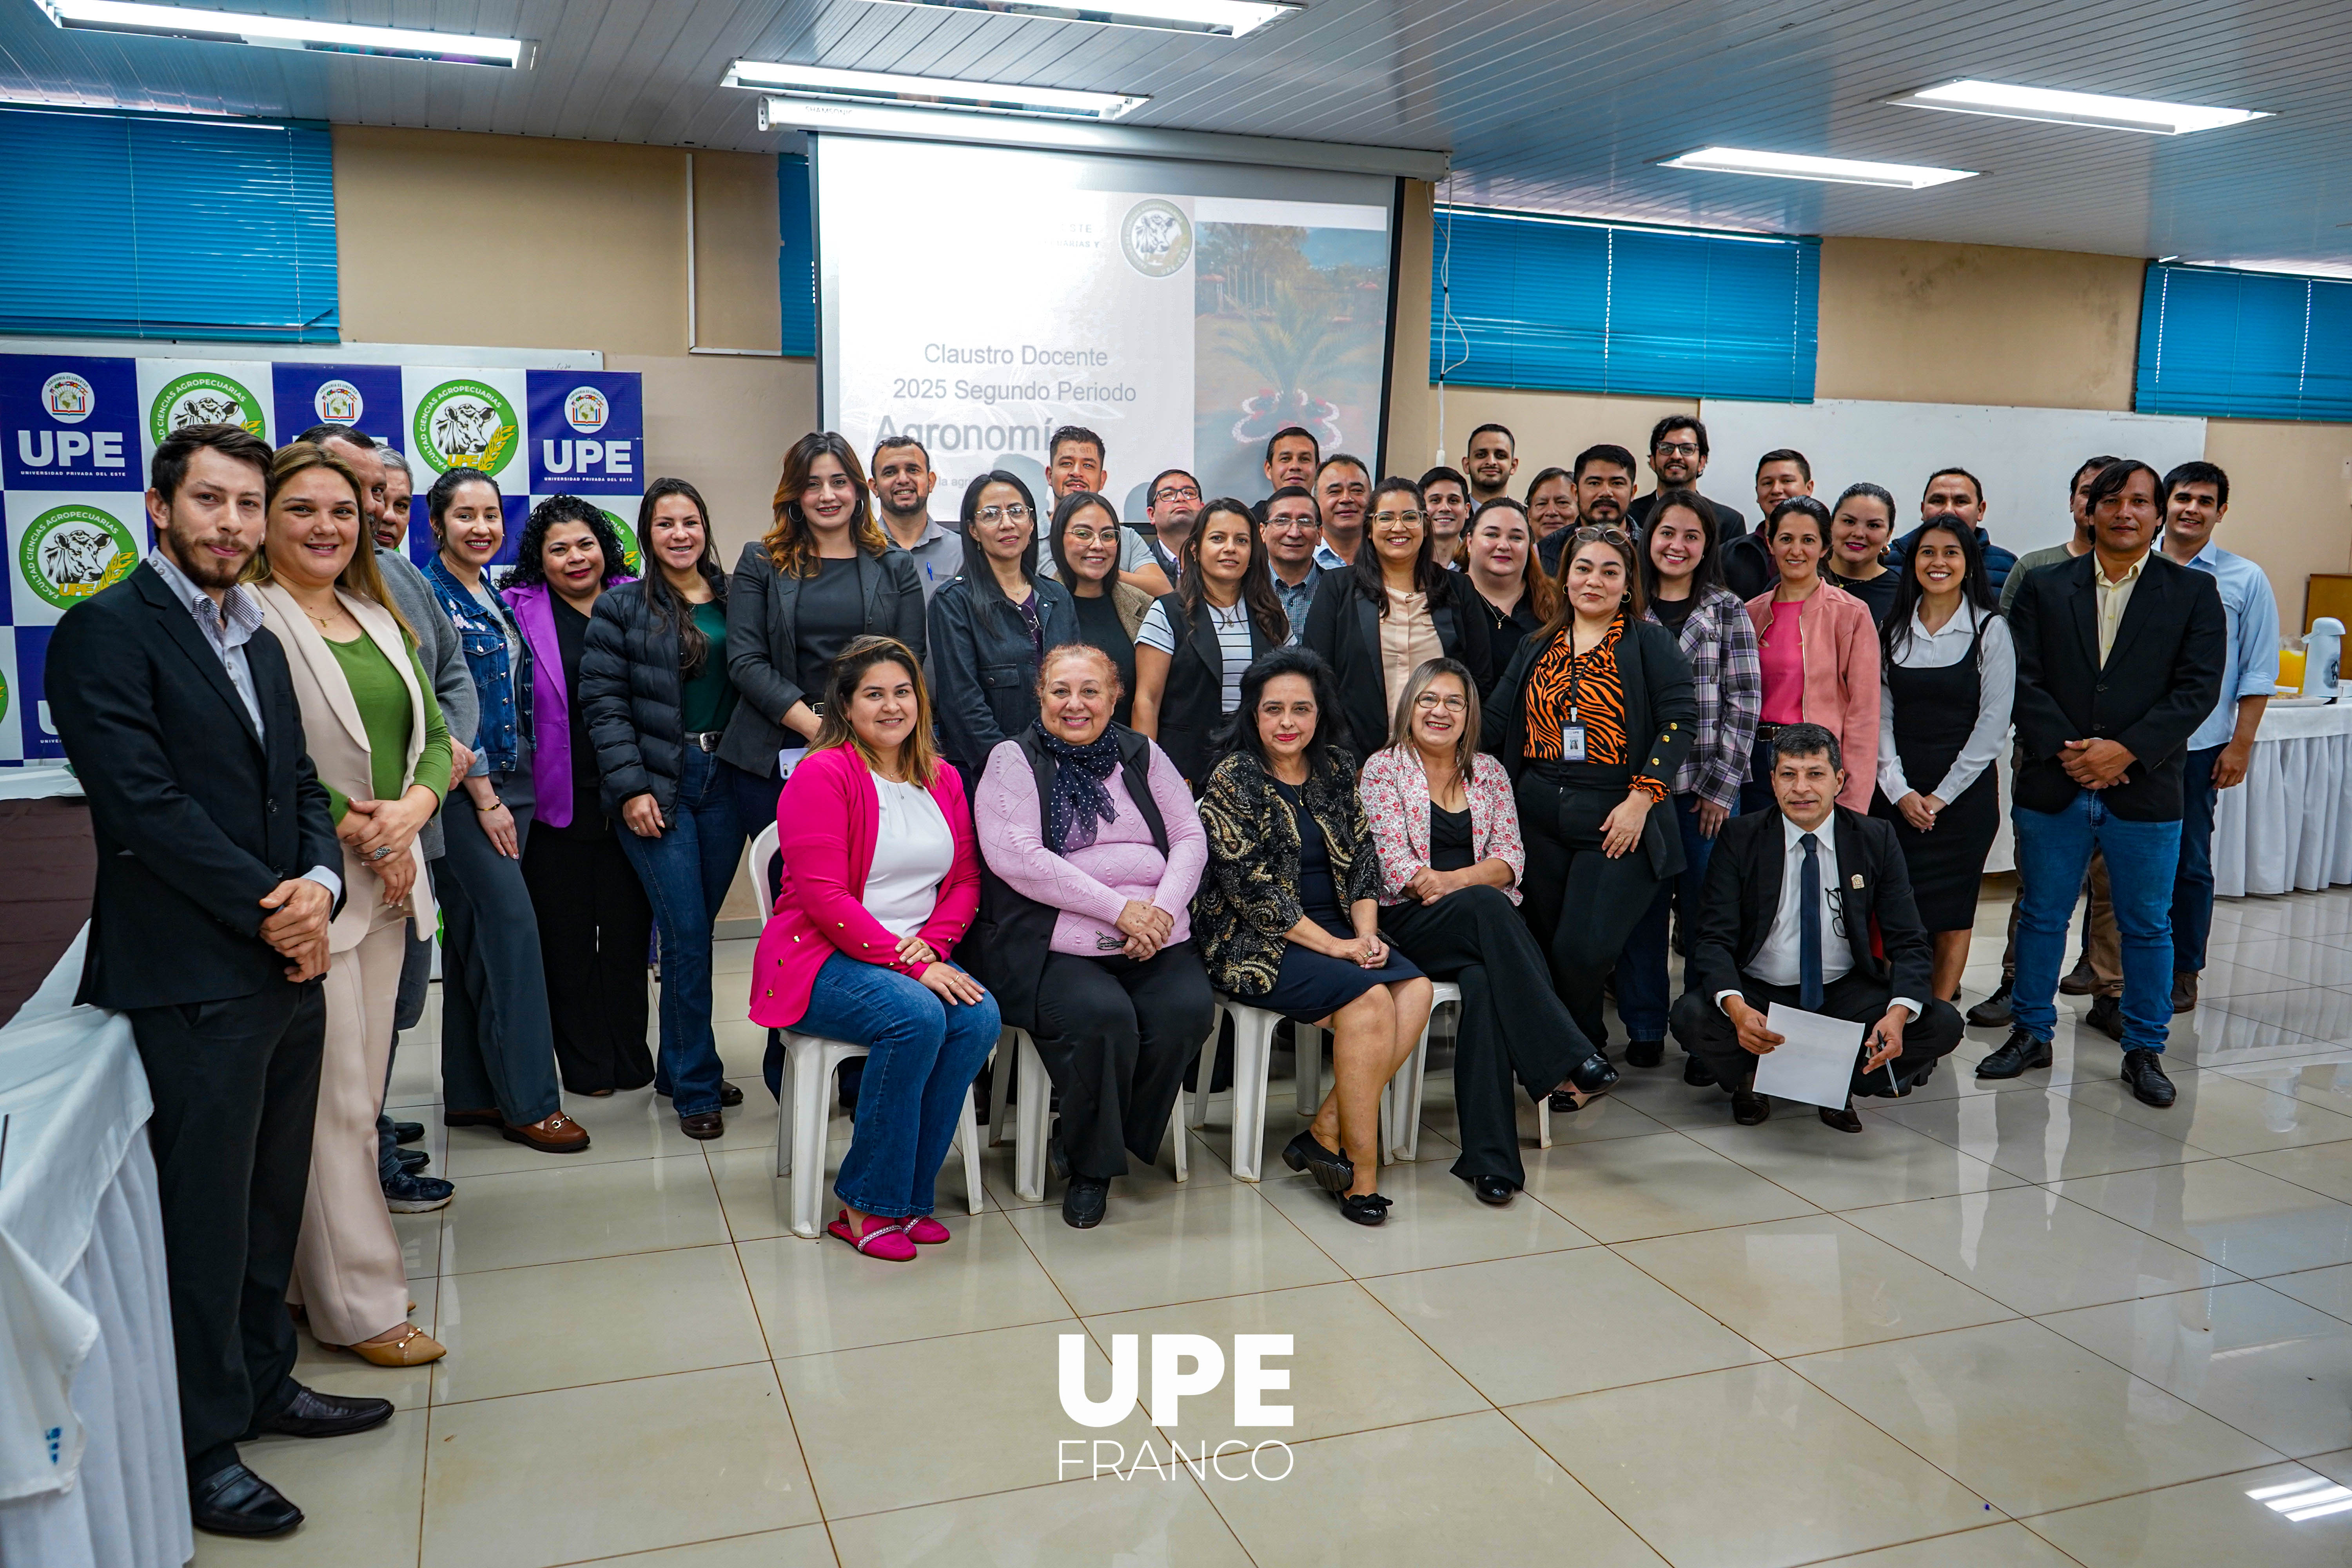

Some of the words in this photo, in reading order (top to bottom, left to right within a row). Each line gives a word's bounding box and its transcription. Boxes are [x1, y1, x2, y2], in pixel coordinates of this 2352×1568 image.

[924, 343, 1014, 363] Claustro
[1022, 345, 1108, 366] Docente
[46, 376, 65, 387] SABIDURIA
[72, 377, 88, 388] LIBERTAD
[437, 386, 502, 408] AGROPECUARIAS
[893, 378, 947, 399] 2025
[955, 379, 1050, 405] Segundo
[1058, 381, 1136, 402] Periodo
[157, 391, 176, 427] CIENCIAS
[175, 379, 246, 402] AGROPECUARIAS
[420, 397, 438, 432] CIENCIAS
[18, 430, 125, 467] UPE
[420, 434, 448, 470] FACULTAD
[447, 454, 479, 467] UPE
[543, 439, 632, 474] UPE
[45, 511, 119, 534] AGROPECUARIAS
[26, 524, 46, 560] CIENCIAS
[28, 563, 60, 599] FACULTAD
[58, 583, 94, 596] UPE
